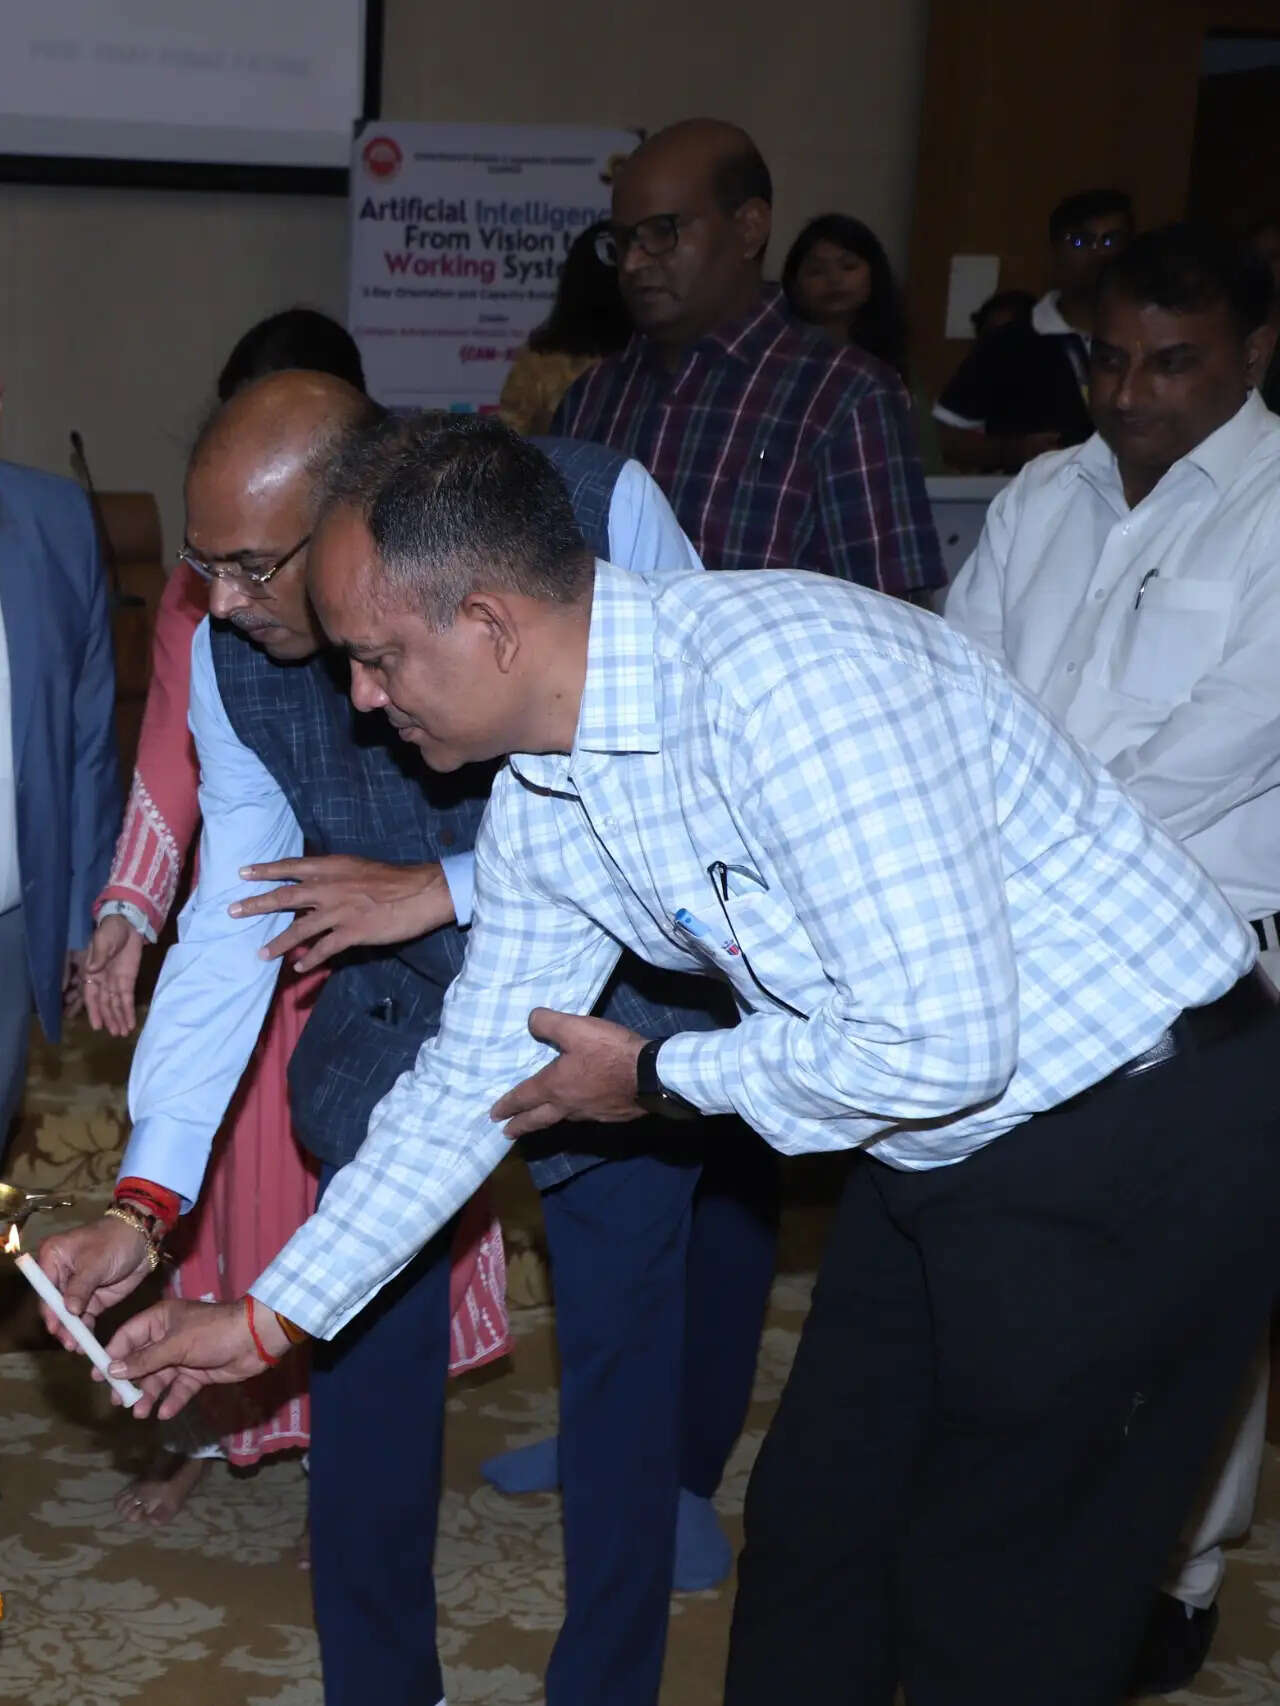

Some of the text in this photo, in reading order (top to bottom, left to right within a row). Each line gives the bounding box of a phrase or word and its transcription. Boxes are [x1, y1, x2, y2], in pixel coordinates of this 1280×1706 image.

[360, 198, 612, 230] Artificial Intelligenc
[405, 226, 470, 249] From
[479, 227, 554, 252] Vision
[384, 252, 497, 284] Working
